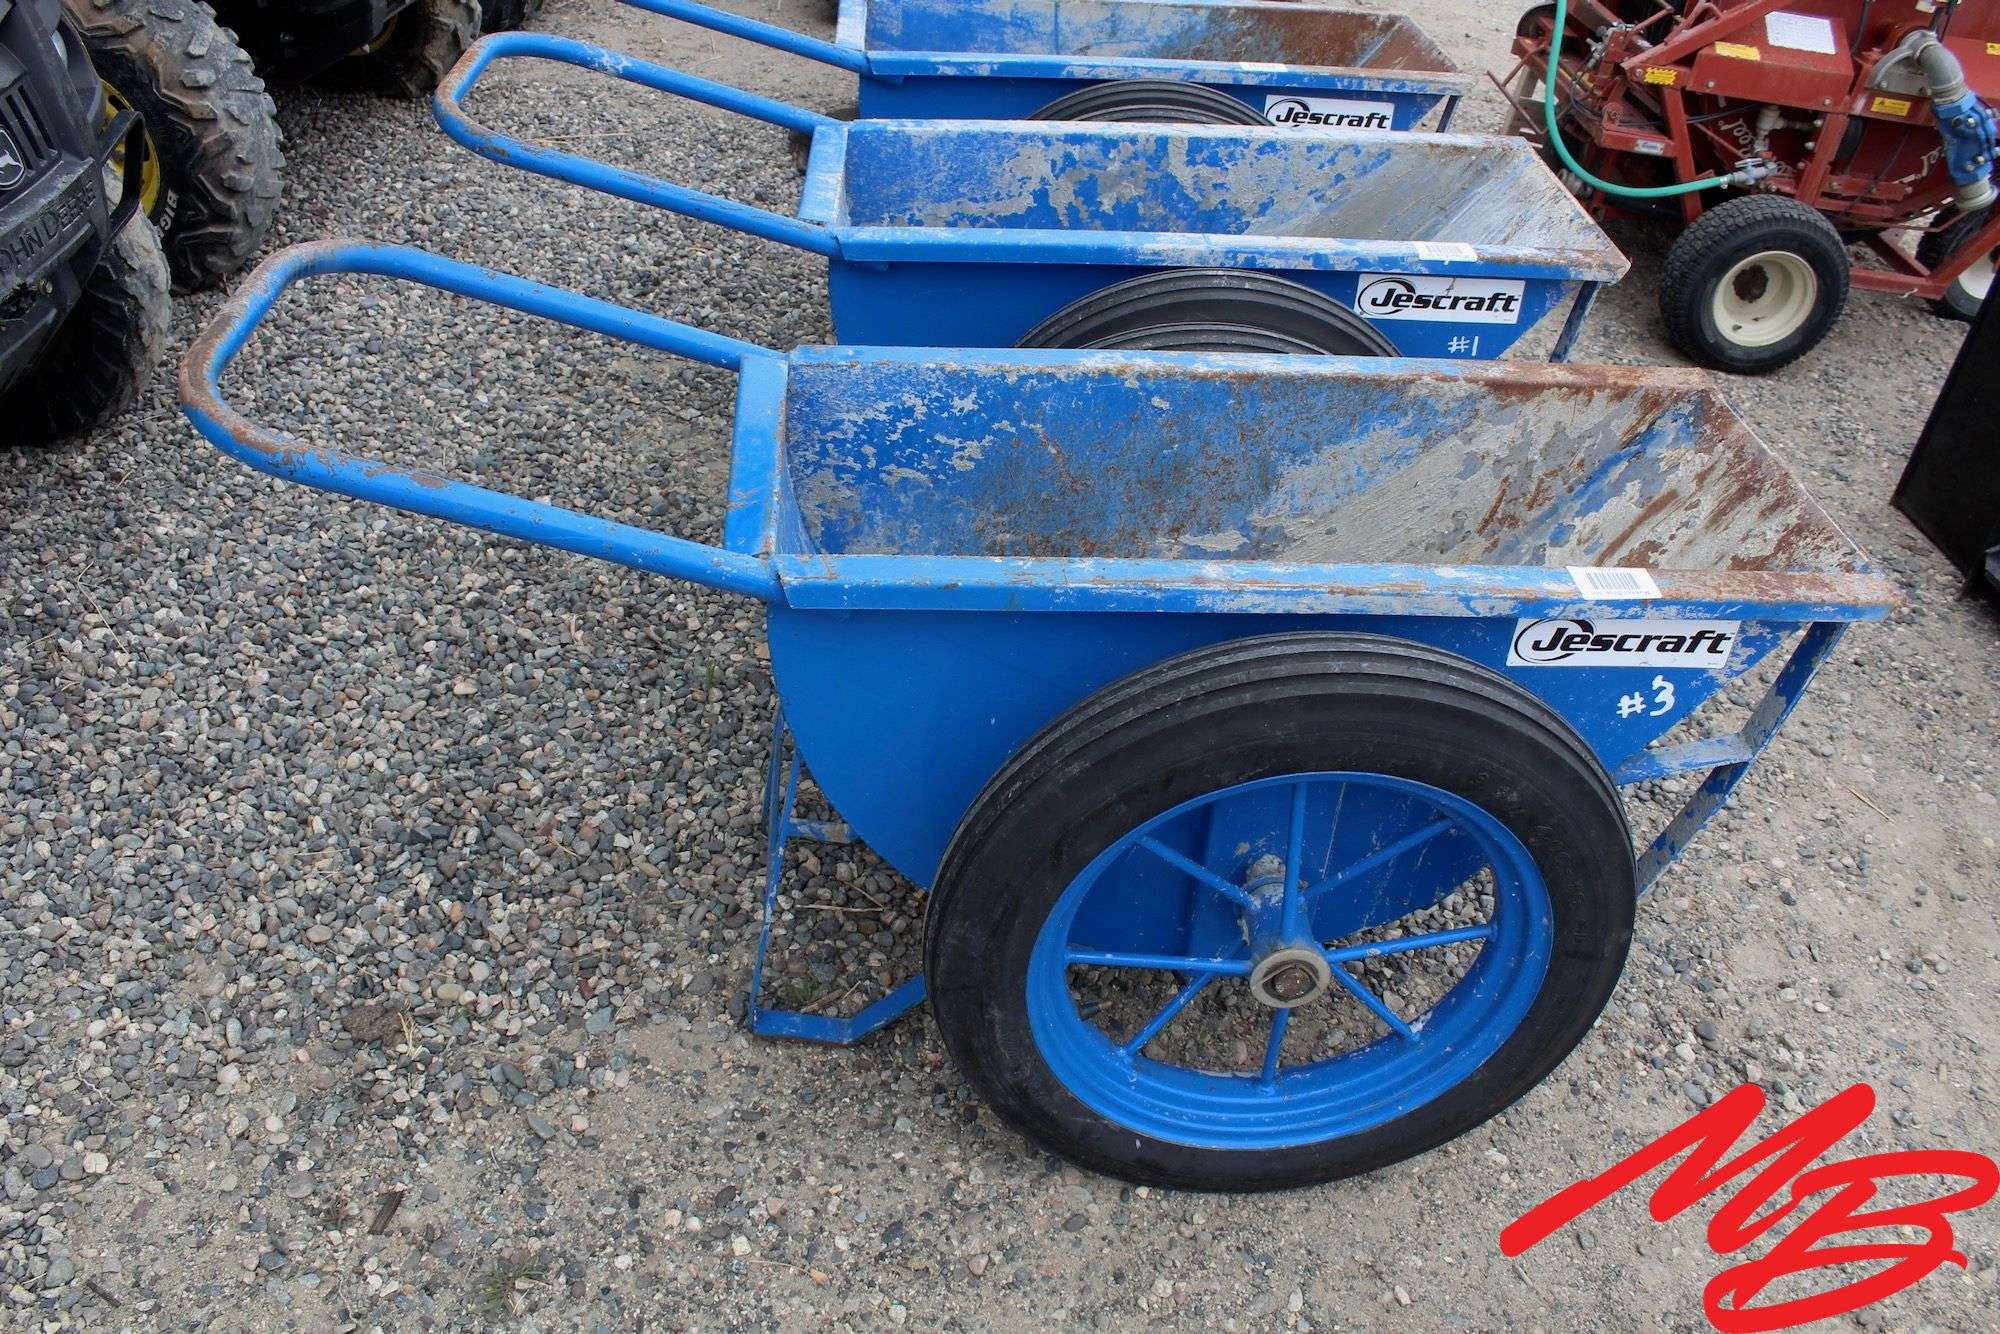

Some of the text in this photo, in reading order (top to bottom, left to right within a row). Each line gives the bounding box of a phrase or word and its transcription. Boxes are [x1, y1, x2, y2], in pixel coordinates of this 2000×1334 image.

[1275, 106, 1391, 129] Jescraft
[157, 188, 180, 238] BIG
[1370, 287, 1520, 313] Jescraft
[1448, 335, 1479, 357] #1
[1531, 626, 1732, 655] Jescraft
[1617, 674, 1676, 719] #3
